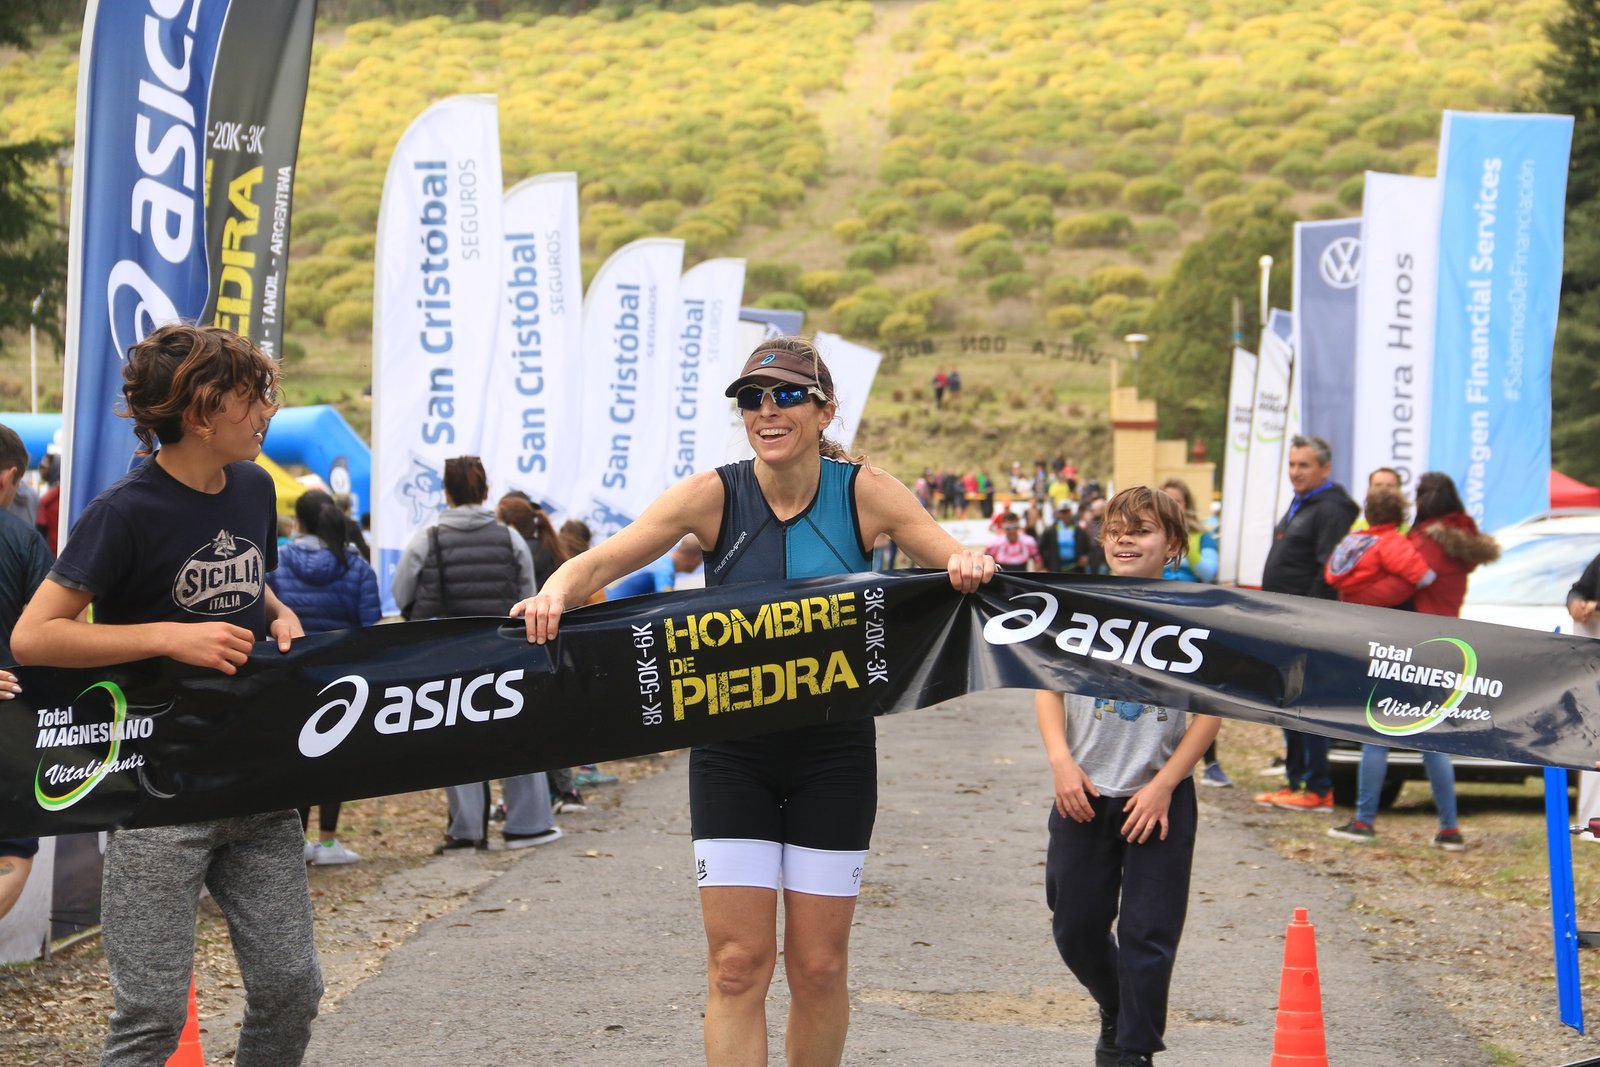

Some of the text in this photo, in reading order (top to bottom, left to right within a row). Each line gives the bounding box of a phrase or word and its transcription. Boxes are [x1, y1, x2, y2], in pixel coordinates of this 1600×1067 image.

[207, 121, 266, 154] -20K-3K
[261, 271, 279, 325] TANDIL
[270, 166, 292, 255] ARGENTINA
[457, 158, 480, 261] SEGUROS
[213, 165, 264, 338] EDRA
[544, 229, 565, 316] SEGUROS
[413, 160, 455, 445] San Cristóbal
[646, 285, 658, 358] SEGUROS
[707, 298, 723, 363] SEGUROS
[504, 231, 546, 474] San Cristóbal
[1387, 252, 1414, 487] omera Hnos
[1464, 158, 1502, 528] swagen Financial Services
[602, 283, 641, 490] San Cristóbal
[673, 300, 706, 479] San Cristóbal
[182, 555, 260, 598] SICILIA
[209, 594, 241, 611] ITALIA
[663, 591, 858, 653] HOMBRE
[863, 587, 889, 685] 3K-20K-3K
[1368, 641, 1413, 663] Total
[631, 622, 663, 726] 8K-50K-6K
[669, 656, 697, 676] DE
[671, 649, 860, 722] PIEDRA
[1367, 659, 1504, 698] MAGNESIANO
[35, 717, 154, 749] MAGNESIANO
[37, 706, 73, 727] Total
[1377, 696, 1492, 721] Vitalizante
[45, 752, 145, 785] Vitalizante
